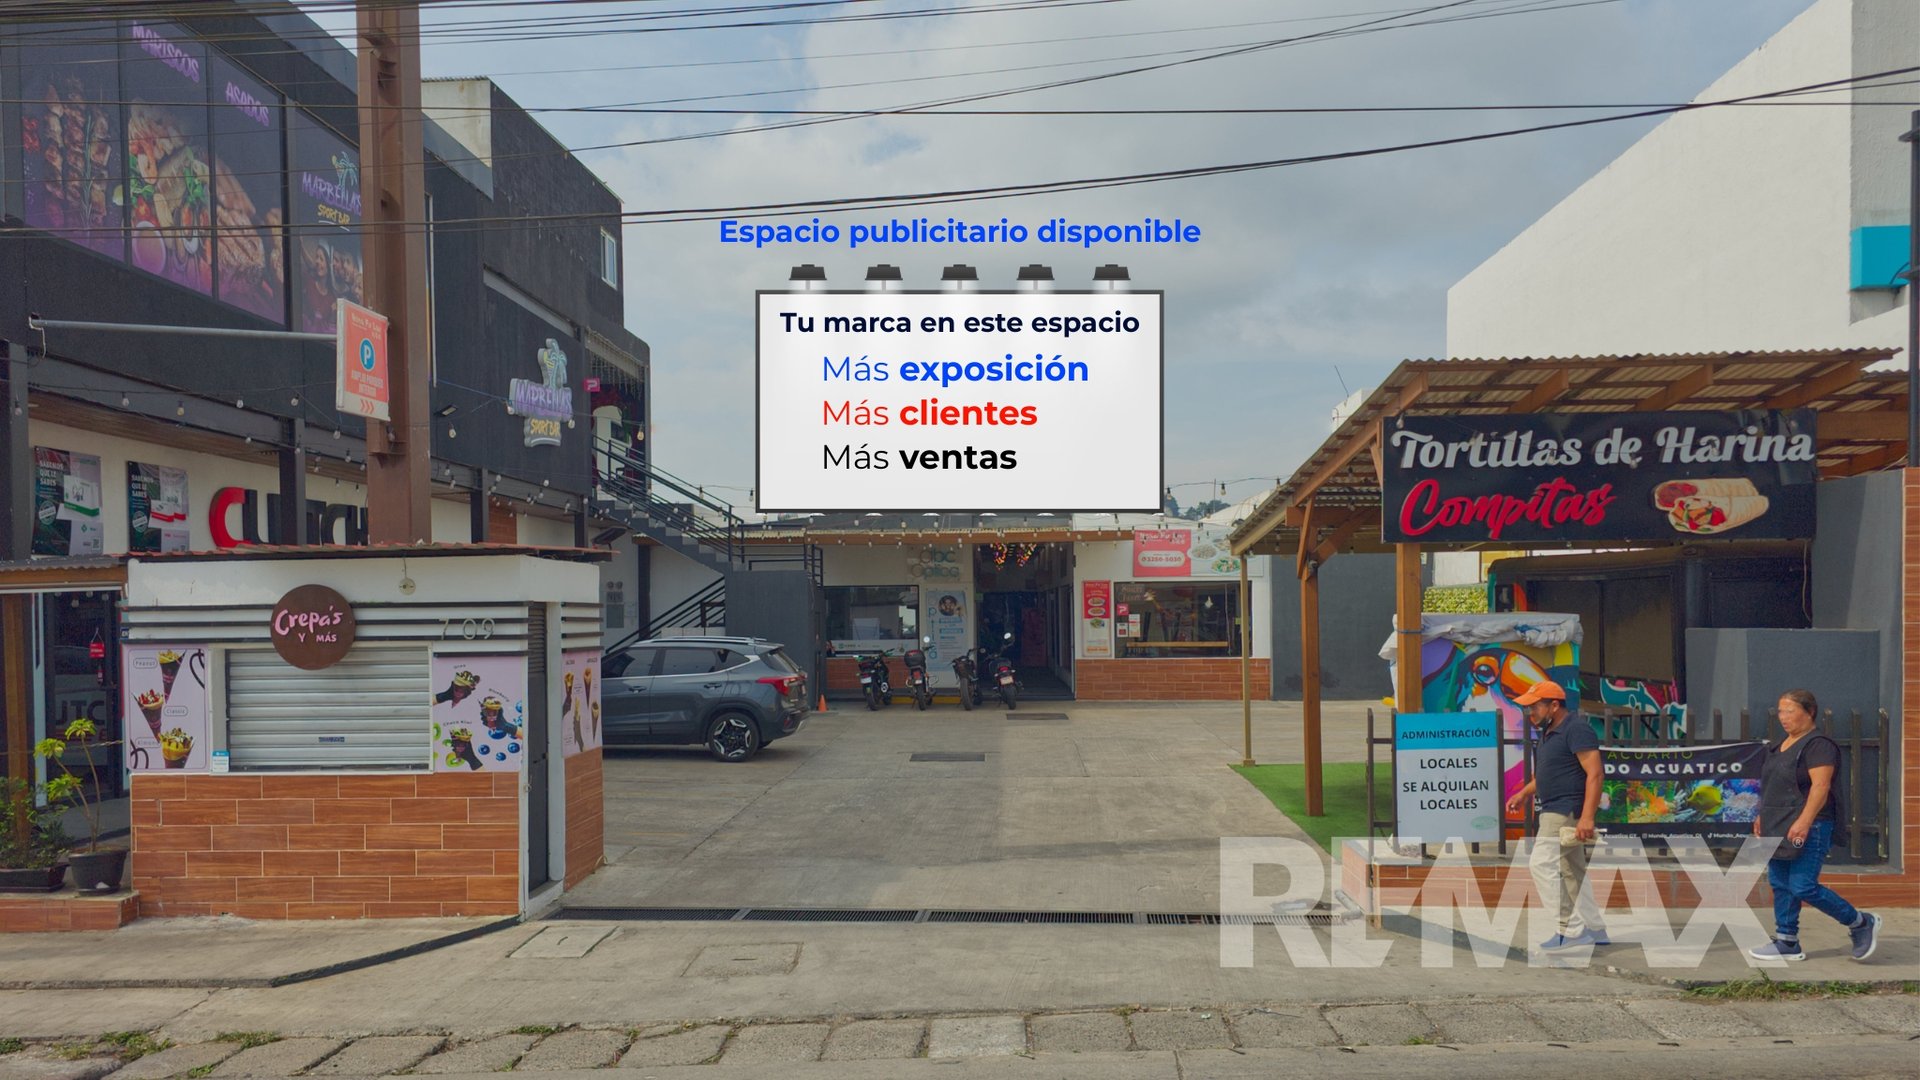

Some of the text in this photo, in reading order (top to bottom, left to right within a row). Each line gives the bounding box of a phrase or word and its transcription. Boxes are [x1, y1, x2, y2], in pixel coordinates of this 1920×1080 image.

[133, 21, 200, 83] MARISCOS
[226, 82, 270, 127] ASADOS
[1391, 425, 1816, 469] Tortillas de Harina
[1400, 476, 1617, 540] Compitas
[438, 617, 496, 641] 709
[298, 631, 337, 643] Y MÁS
[1402, 727, 1490, 740] ADMINISTRACIÓN
[1607, 750, 1694, 760] ACUARIO
[1420, 757, 1478, 769] LOCALES
[1640, 762, 1743, 775] ACUATICO
[1402, 780, 1489, 793] SE ALQUILAN
[1420, 799, 1478, 810] LOCALES
